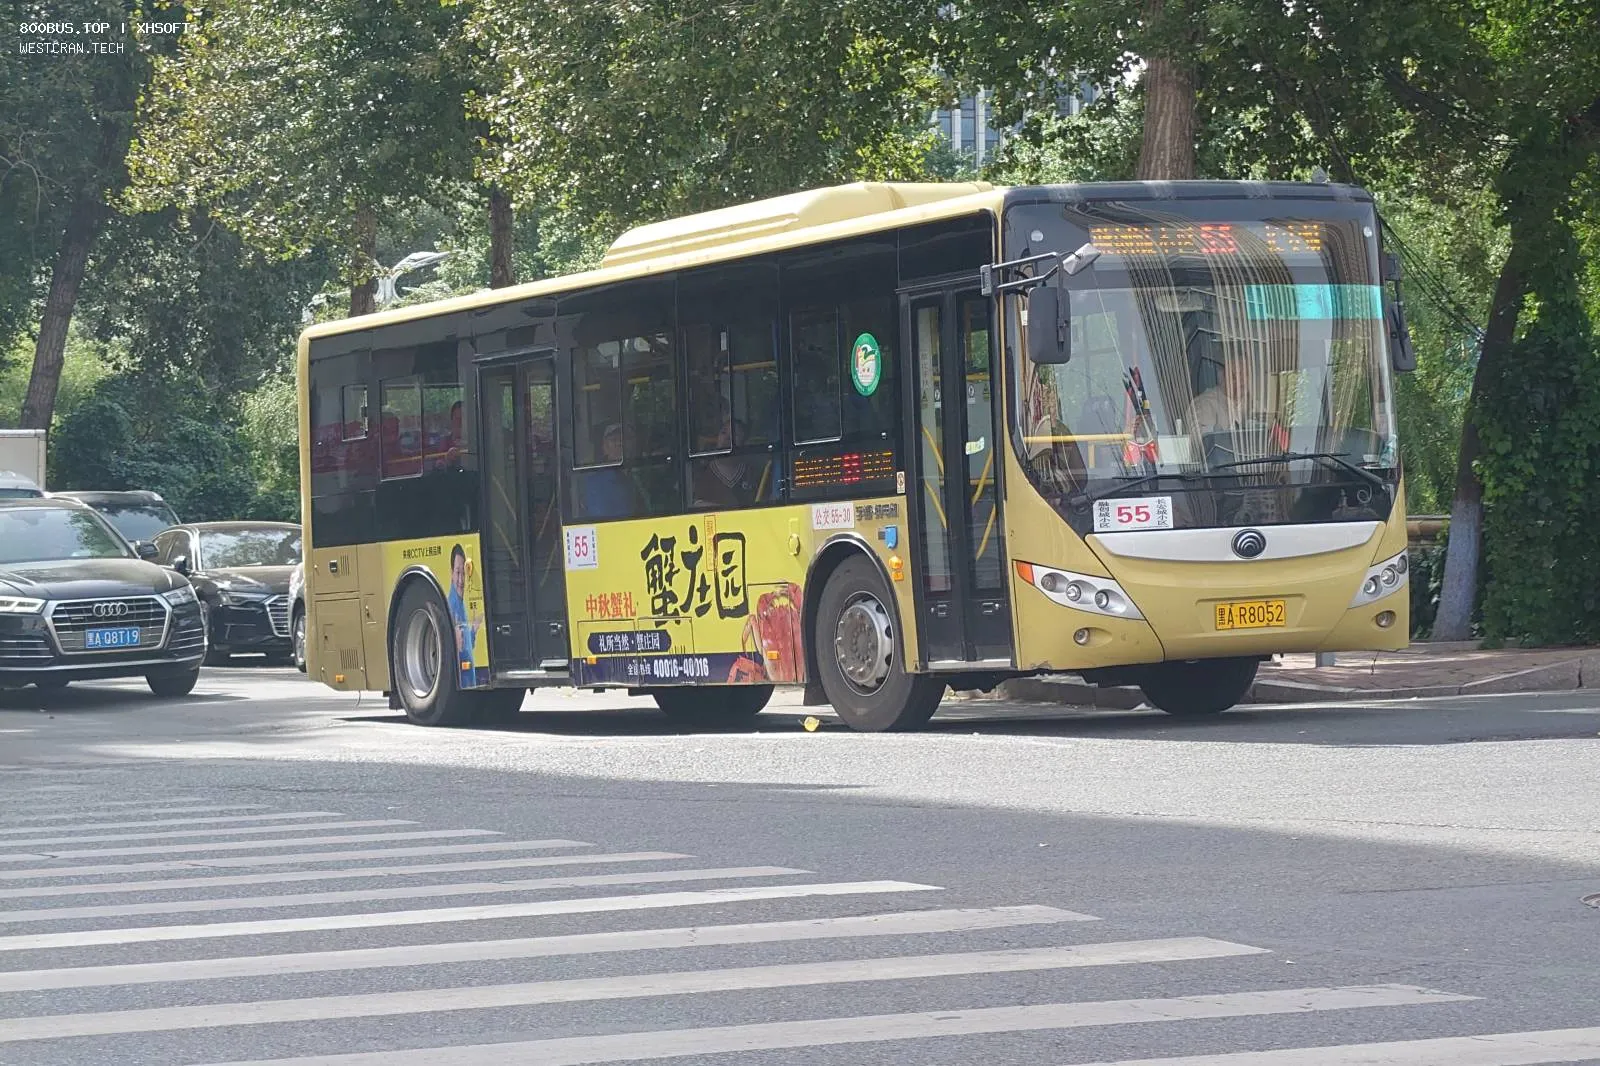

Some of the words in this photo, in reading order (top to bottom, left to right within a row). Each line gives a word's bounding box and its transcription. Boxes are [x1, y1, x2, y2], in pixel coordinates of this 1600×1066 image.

[1117, 505, 1151, 523] 55
[574, 535, 589, 558] 55
[585, 591, 637, 619] 中秋蟹礼
